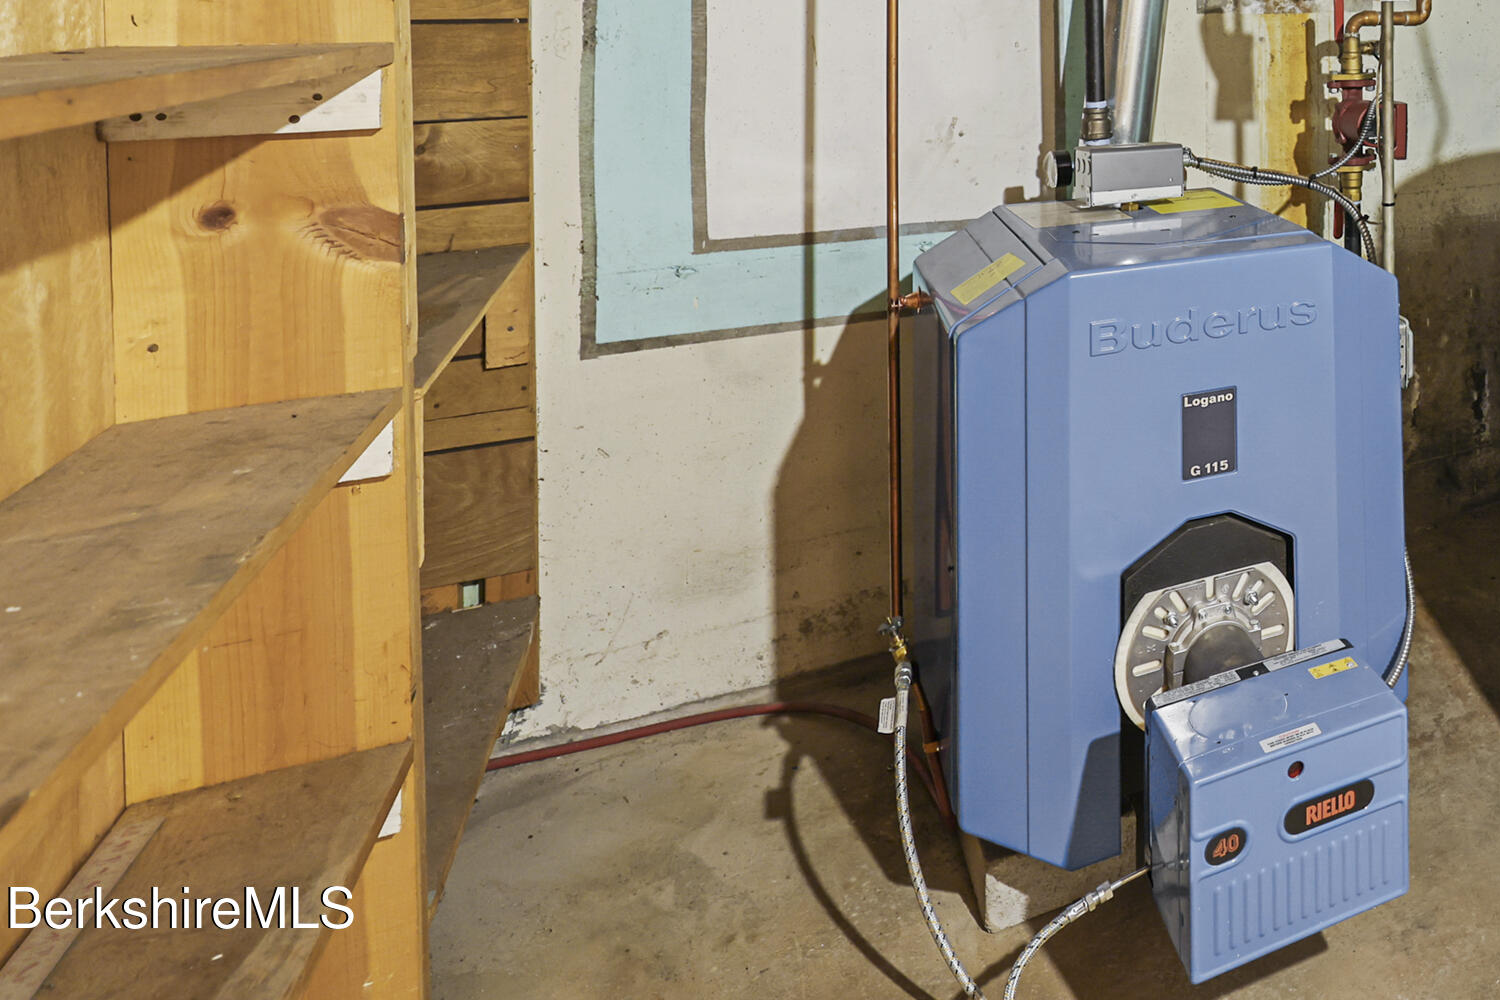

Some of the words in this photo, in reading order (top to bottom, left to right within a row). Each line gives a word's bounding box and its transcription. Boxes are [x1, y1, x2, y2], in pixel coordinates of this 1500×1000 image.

[1088, 300, 1318, 358] Buderus
[1183, 391, 1234, 408] Logano
[1190, 464, 1201, 477] G
[1204, 459, 1229, 474] 115
[1305, 790, 1356, 826] RIELLO
[1212, 833, 1240, 858] 40
